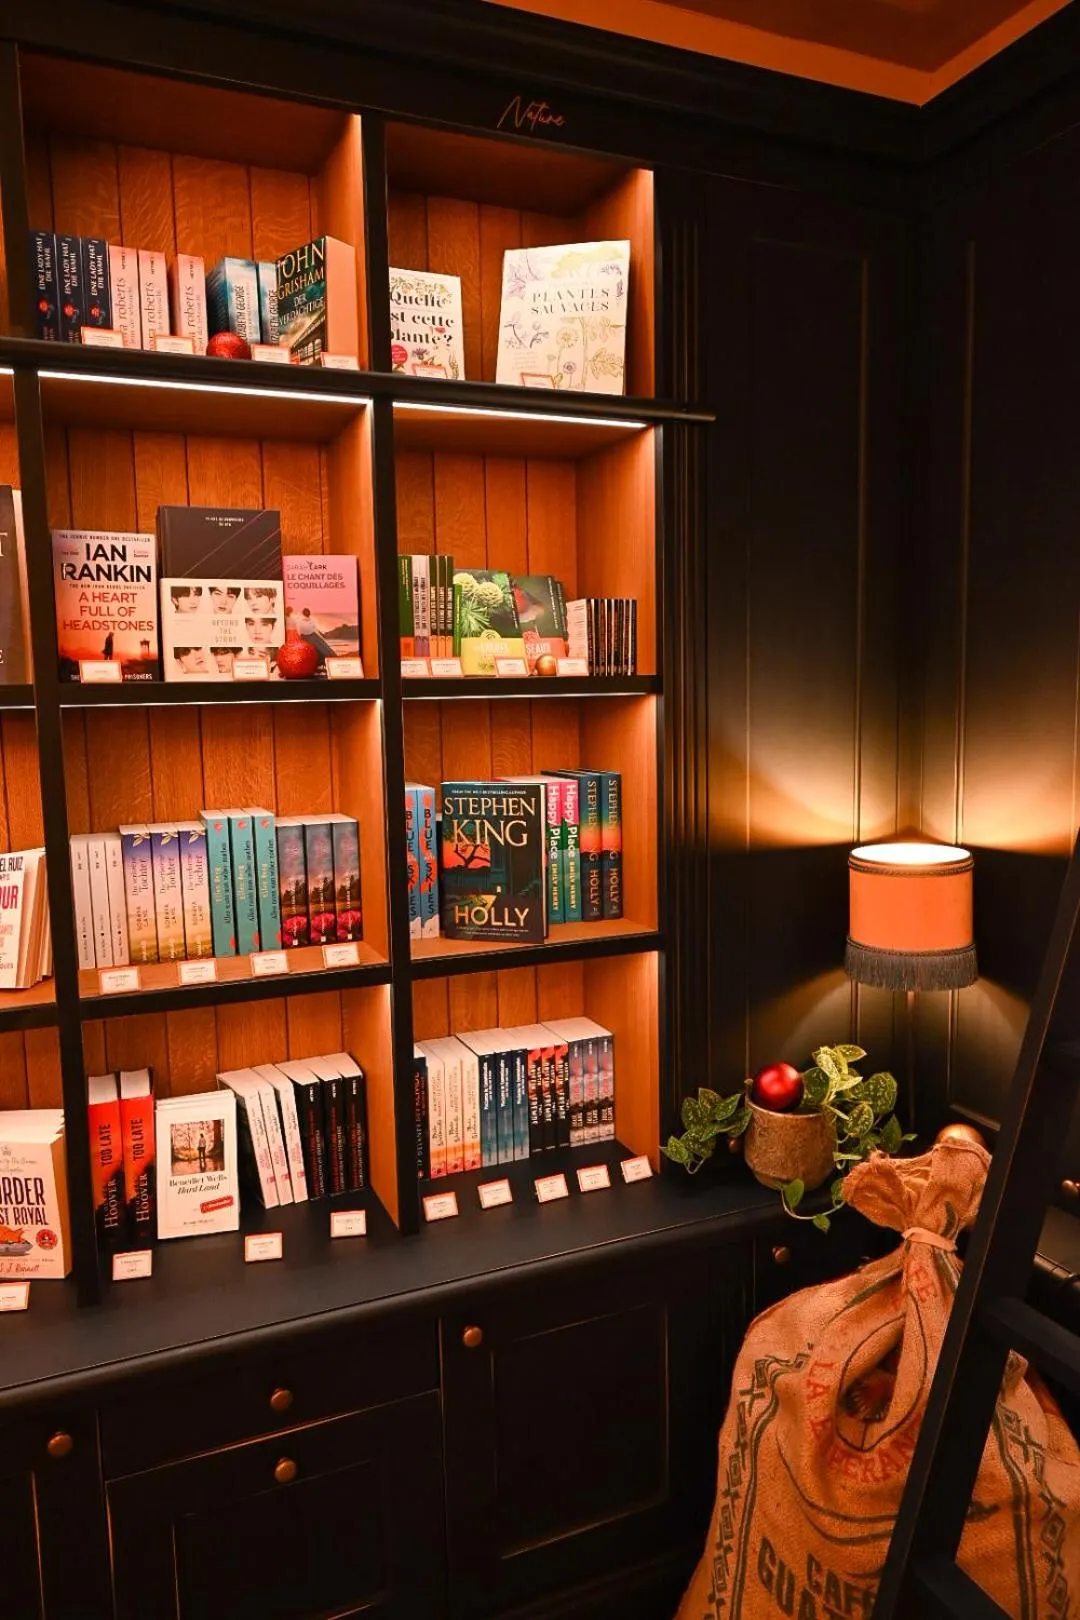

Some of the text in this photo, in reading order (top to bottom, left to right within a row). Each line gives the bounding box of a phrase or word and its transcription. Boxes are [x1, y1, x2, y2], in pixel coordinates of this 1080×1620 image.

[497, 96, 567, 132] Nature
[277, 237, 325, 284] JOHN
[114, 278, 127, 320] roberts
[278, 267, 324, 300] GRISHAM
[294, 292, 307, 306] DER
[532, 288, 610, 302] PLANTES
[144, 282, 156, 324] roberts
[184, 286, 196, 327] roberts
[390, 292, 447, 308] Quelle
[530, 301, 609, 314] SAUVAGES
[390, 312, 454, 328] st cette
[86, 542, 127, 562] IAN
[61, 562, 152, 582] RANKIN
[78, 592, 138, 604] A HEART
[80, 606, 137, 618] FULL OF
[63, 619, 154, 632] HEADSTONES
[444, 797, 536, 816] STEPHEN
[548, 785, 559, 826] Happy
[564, 784, 577, 824] Happy
[452, 820, 528, 846] KING
[550, 828, 560, 860] Place
[568, 826, 578, 858] Place
[8, 856, 24, 871] RUIZ
[140, 859, 148, 893] Tochter
[167, 857, 176, 890] Tochter
[406, 810, 417, 916] BLUE SKIES
[424, 808, 435, 914] BLUE SKIES
[568, 861, 576, 882] EMILY
[590, 870, 599, 905] HOLLY
[609, 868, 619, 902] HOLLY
[454, 905, 530, 926] HOLLY
[100, 1122, 112, 1166] TOO LATE
[130, 1118, 144, 1161] TOO LATE
[14, 1207, 49, 1226] ROYAL
